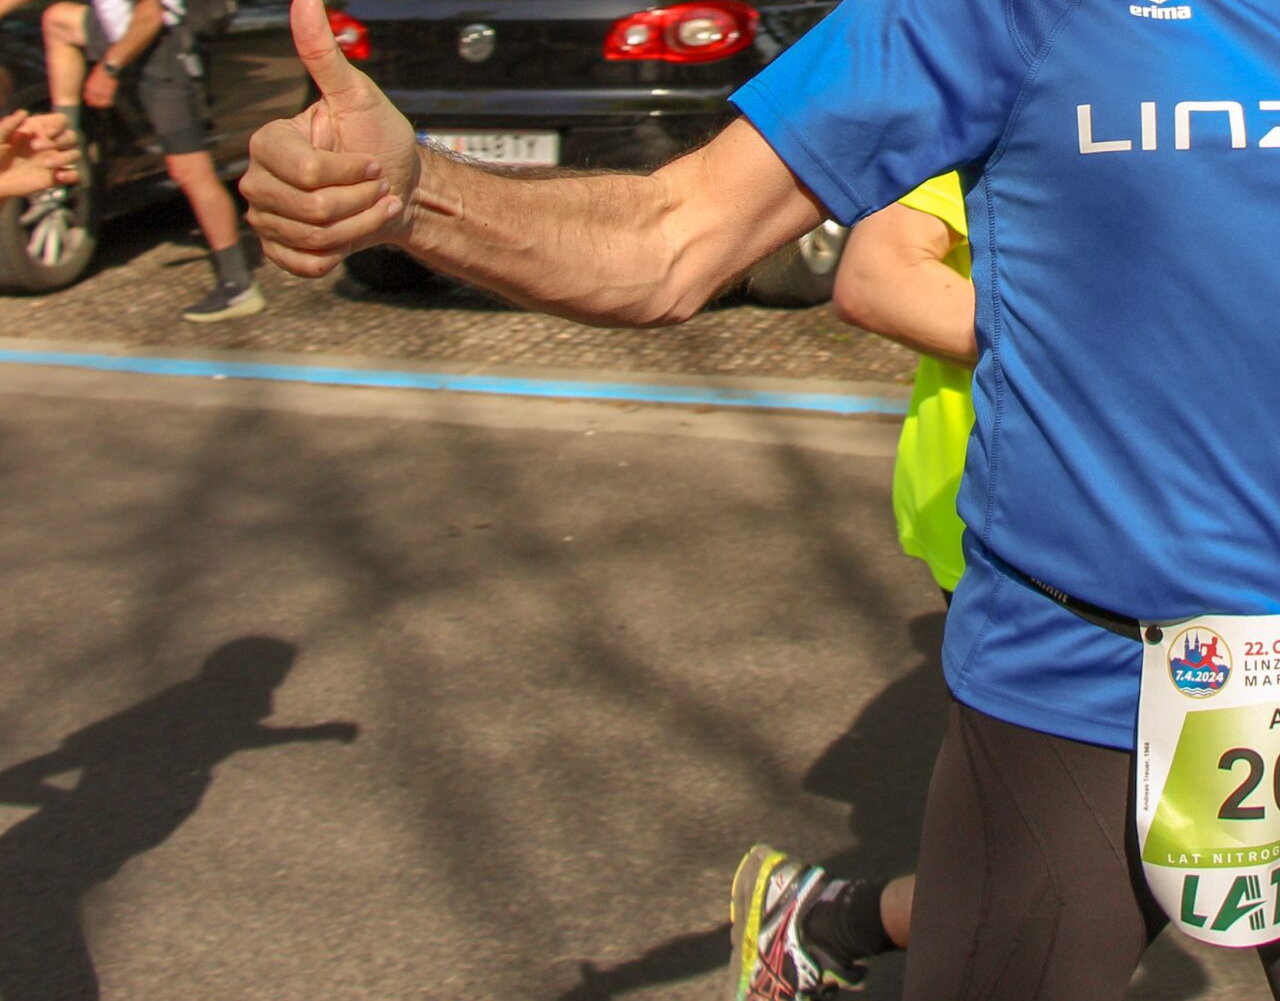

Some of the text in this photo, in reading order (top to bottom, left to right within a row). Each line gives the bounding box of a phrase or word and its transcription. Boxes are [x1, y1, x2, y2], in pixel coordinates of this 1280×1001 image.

[1129, 4, 1192, 20] erima
[1244, 641, 1269, 657] 22.
[1244, 658, 1280, 672] LINZ
[1175, 670, 1225, 683] 7.4.2024
[1167, 852, 1202, 865] LAT
